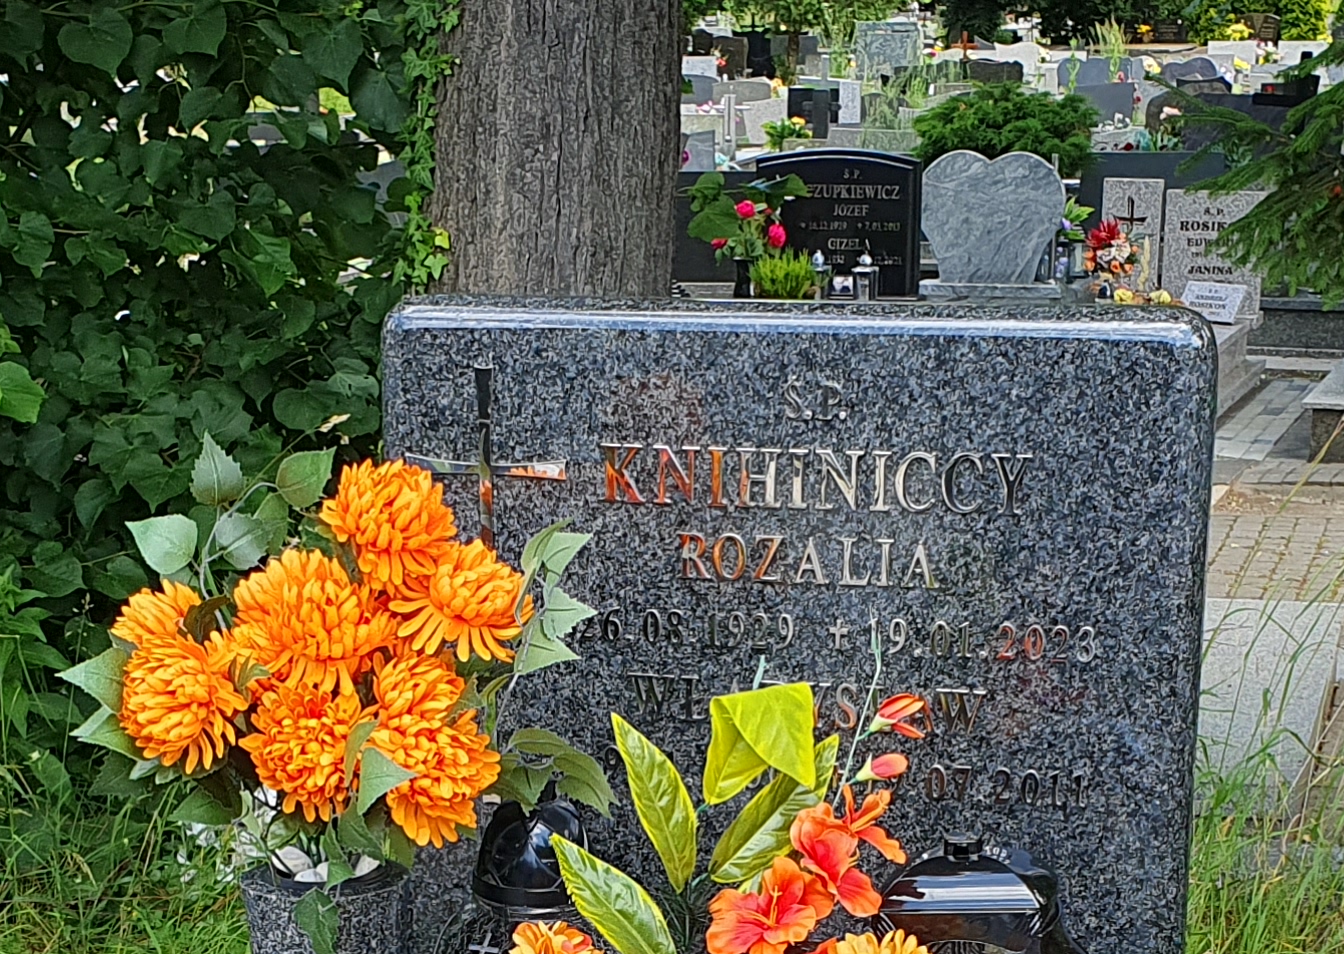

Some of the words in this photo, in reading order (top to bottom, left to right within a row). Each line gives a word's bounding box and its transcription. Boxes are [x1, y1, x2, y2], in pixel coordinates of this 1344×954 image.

[833, 203, 870, 216] JÓZEF
[1180, 221, 1227, 232] ROSIK
[1188, 265, 1233, 275] JANINA
[600, 443, 1033, 515] KNIHINICCY
[677, 532, 941, 588] ROZALIA
